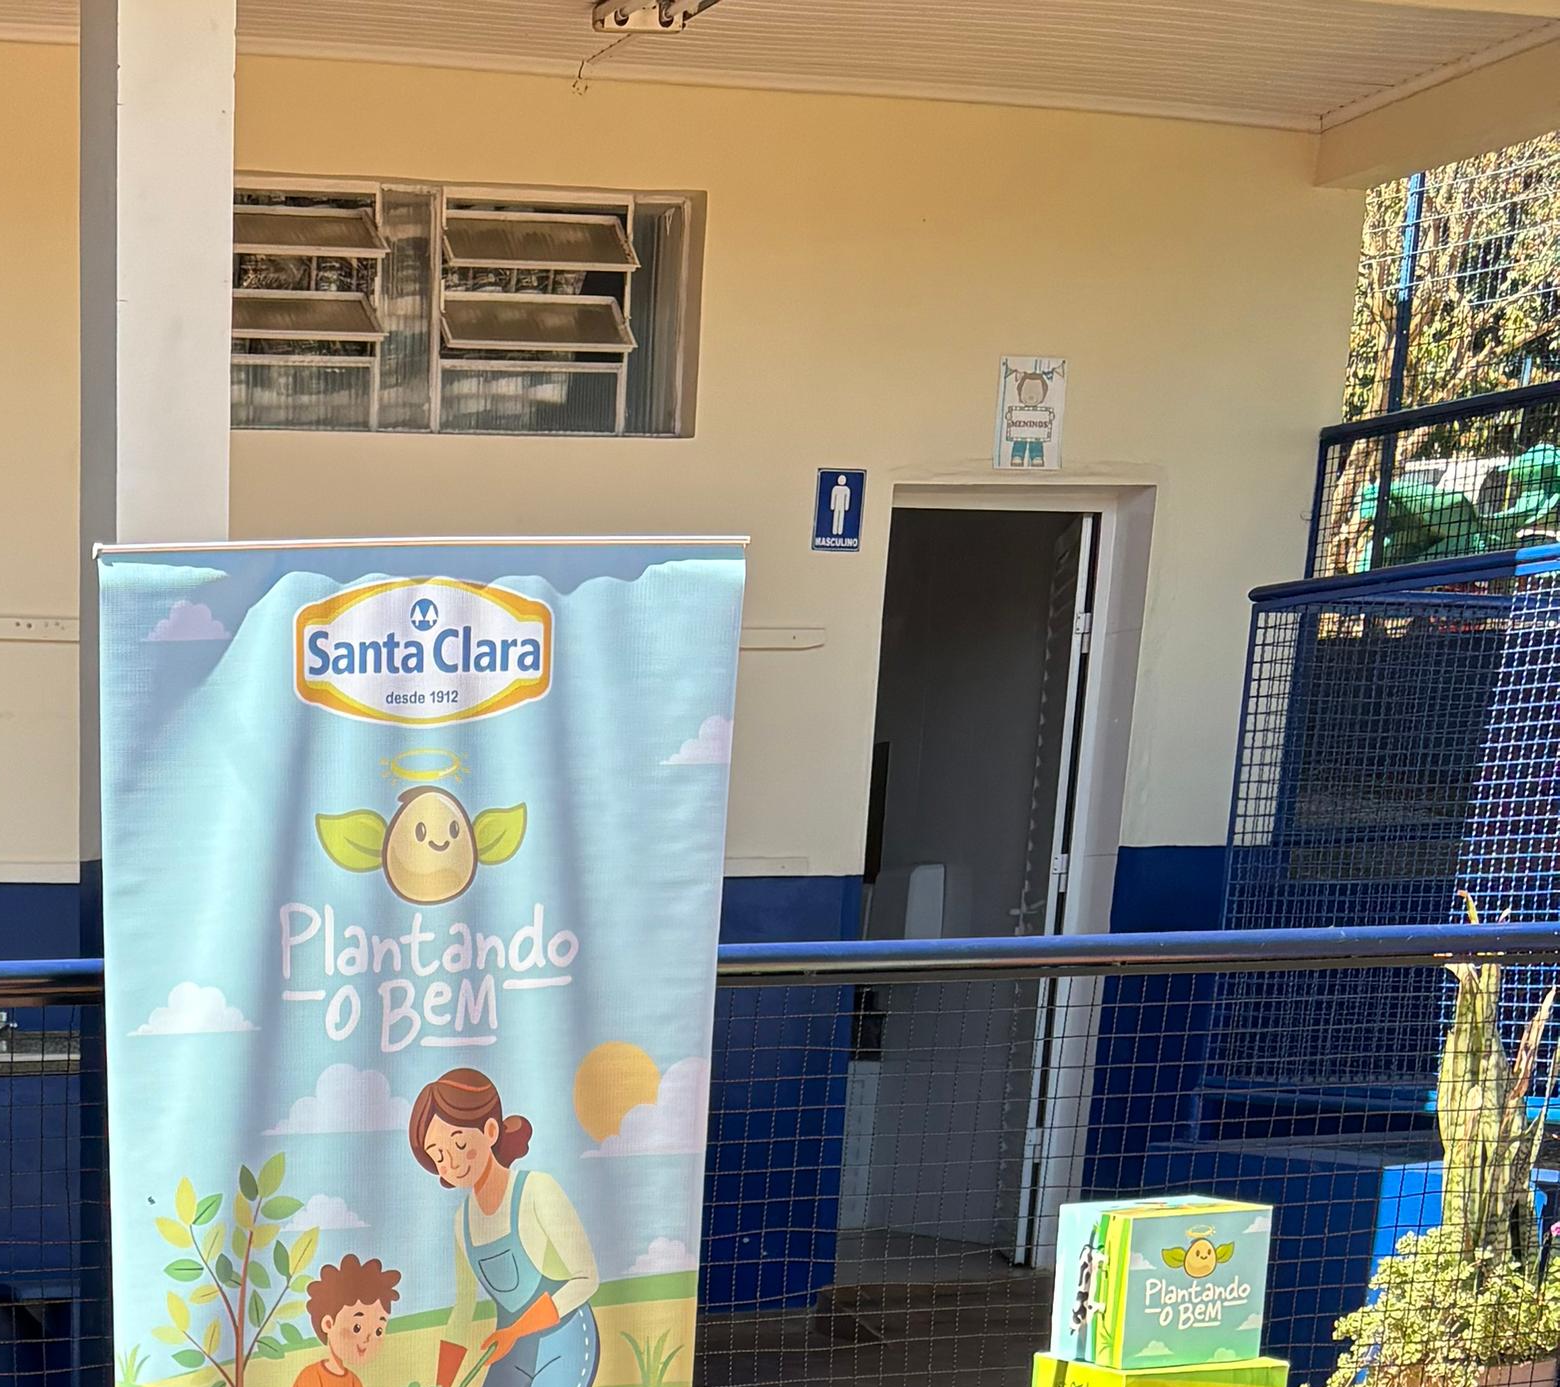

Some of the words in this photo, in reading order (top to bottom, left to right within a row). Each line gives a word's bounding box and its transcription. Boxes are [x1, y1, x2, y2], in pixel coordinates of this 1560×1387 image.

[1010, 420, 1049, 430] MENINOS
[815, 536, 858, 548] MASCULINO
[307, 629, 425, 676] Santa
[433, 626, 541, 673] Clara
[385, 692, 425, 706] desde
[429, 690, 459, 704] 1912
[279, 902, 579, 978] Plantando
[1145, 1275, 1251, 1306] Plantando
